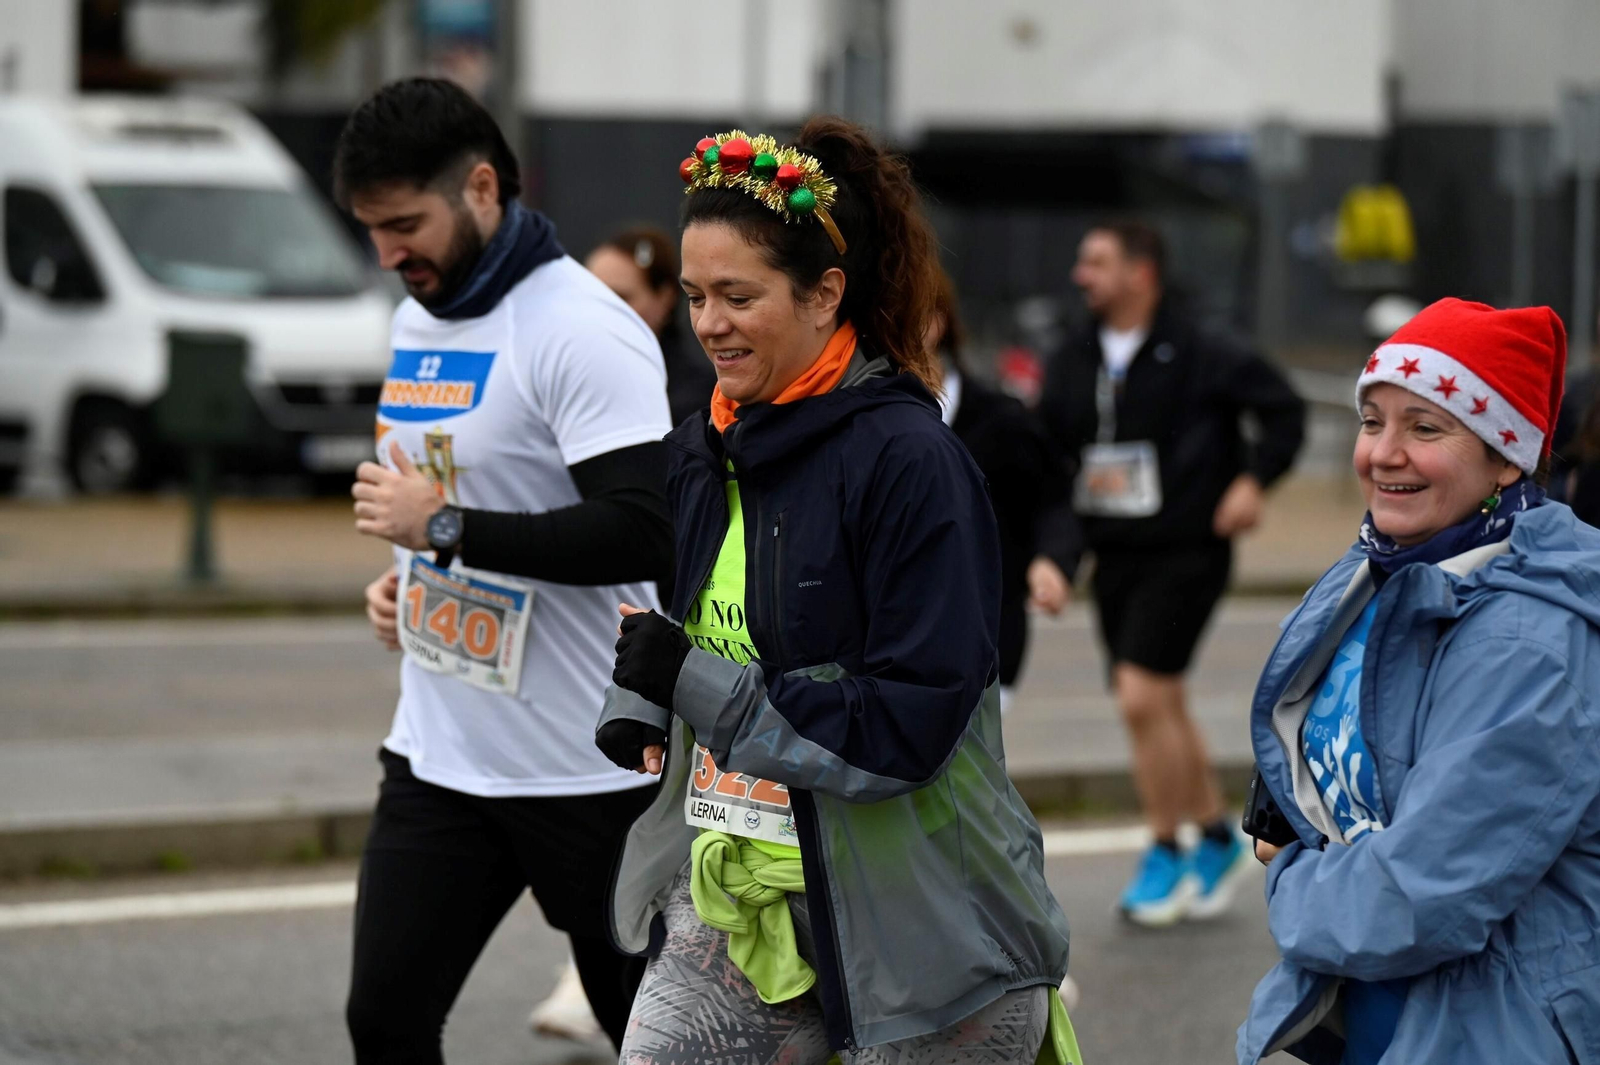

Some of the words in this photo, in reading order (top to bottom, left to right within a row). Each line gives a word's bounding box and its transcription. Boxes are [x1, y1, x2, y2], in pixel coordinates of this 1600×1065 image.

[798, 580, 822, 588] QUECHUA
[406, 583, 501, 660] 140
[710, 599, 743, 632] NO
